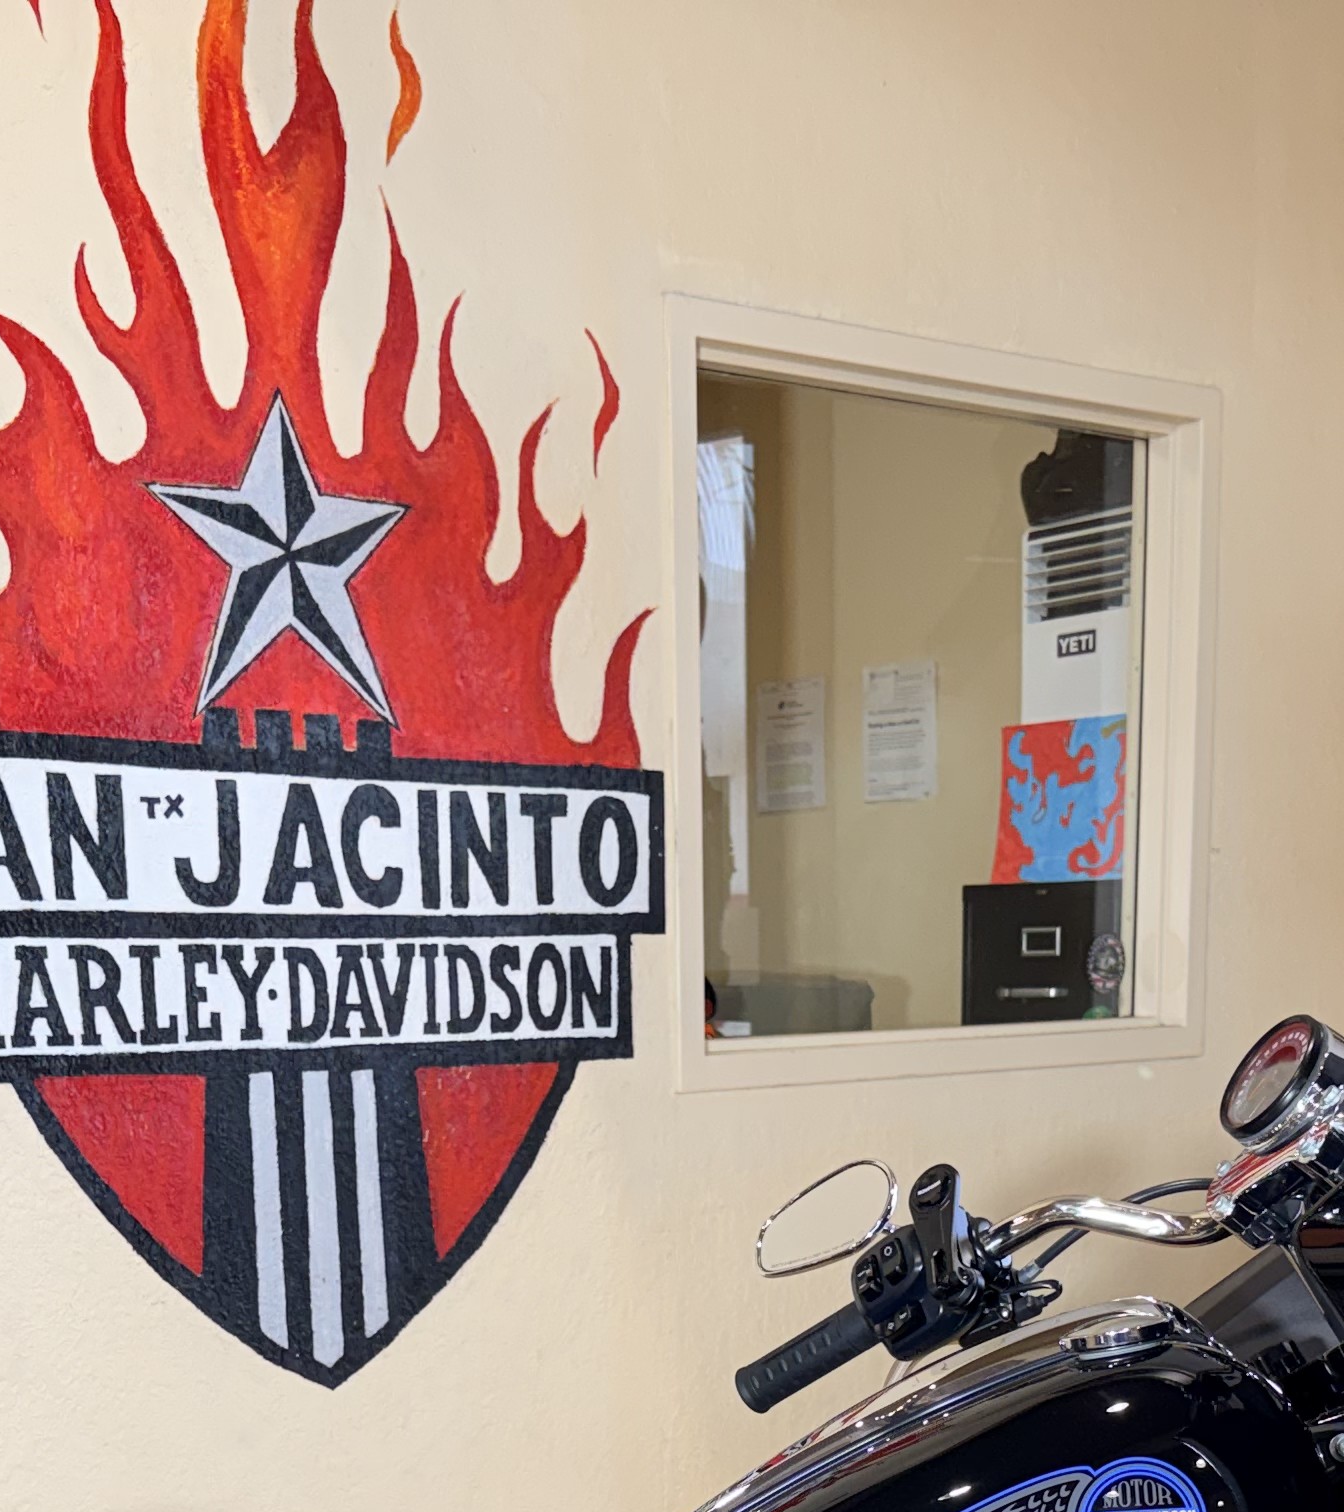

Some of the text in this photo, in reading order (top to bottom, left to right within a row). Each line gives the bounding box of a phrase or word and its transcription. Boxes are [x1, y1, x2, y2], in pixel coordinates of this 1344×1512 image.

[1058, 633, 1094, 654] YETI
[139, 796, 185, 820] TX
[173, 778, 639, 909] JACINTO
[1102, 1478, 1174, 1509] MOTOR
